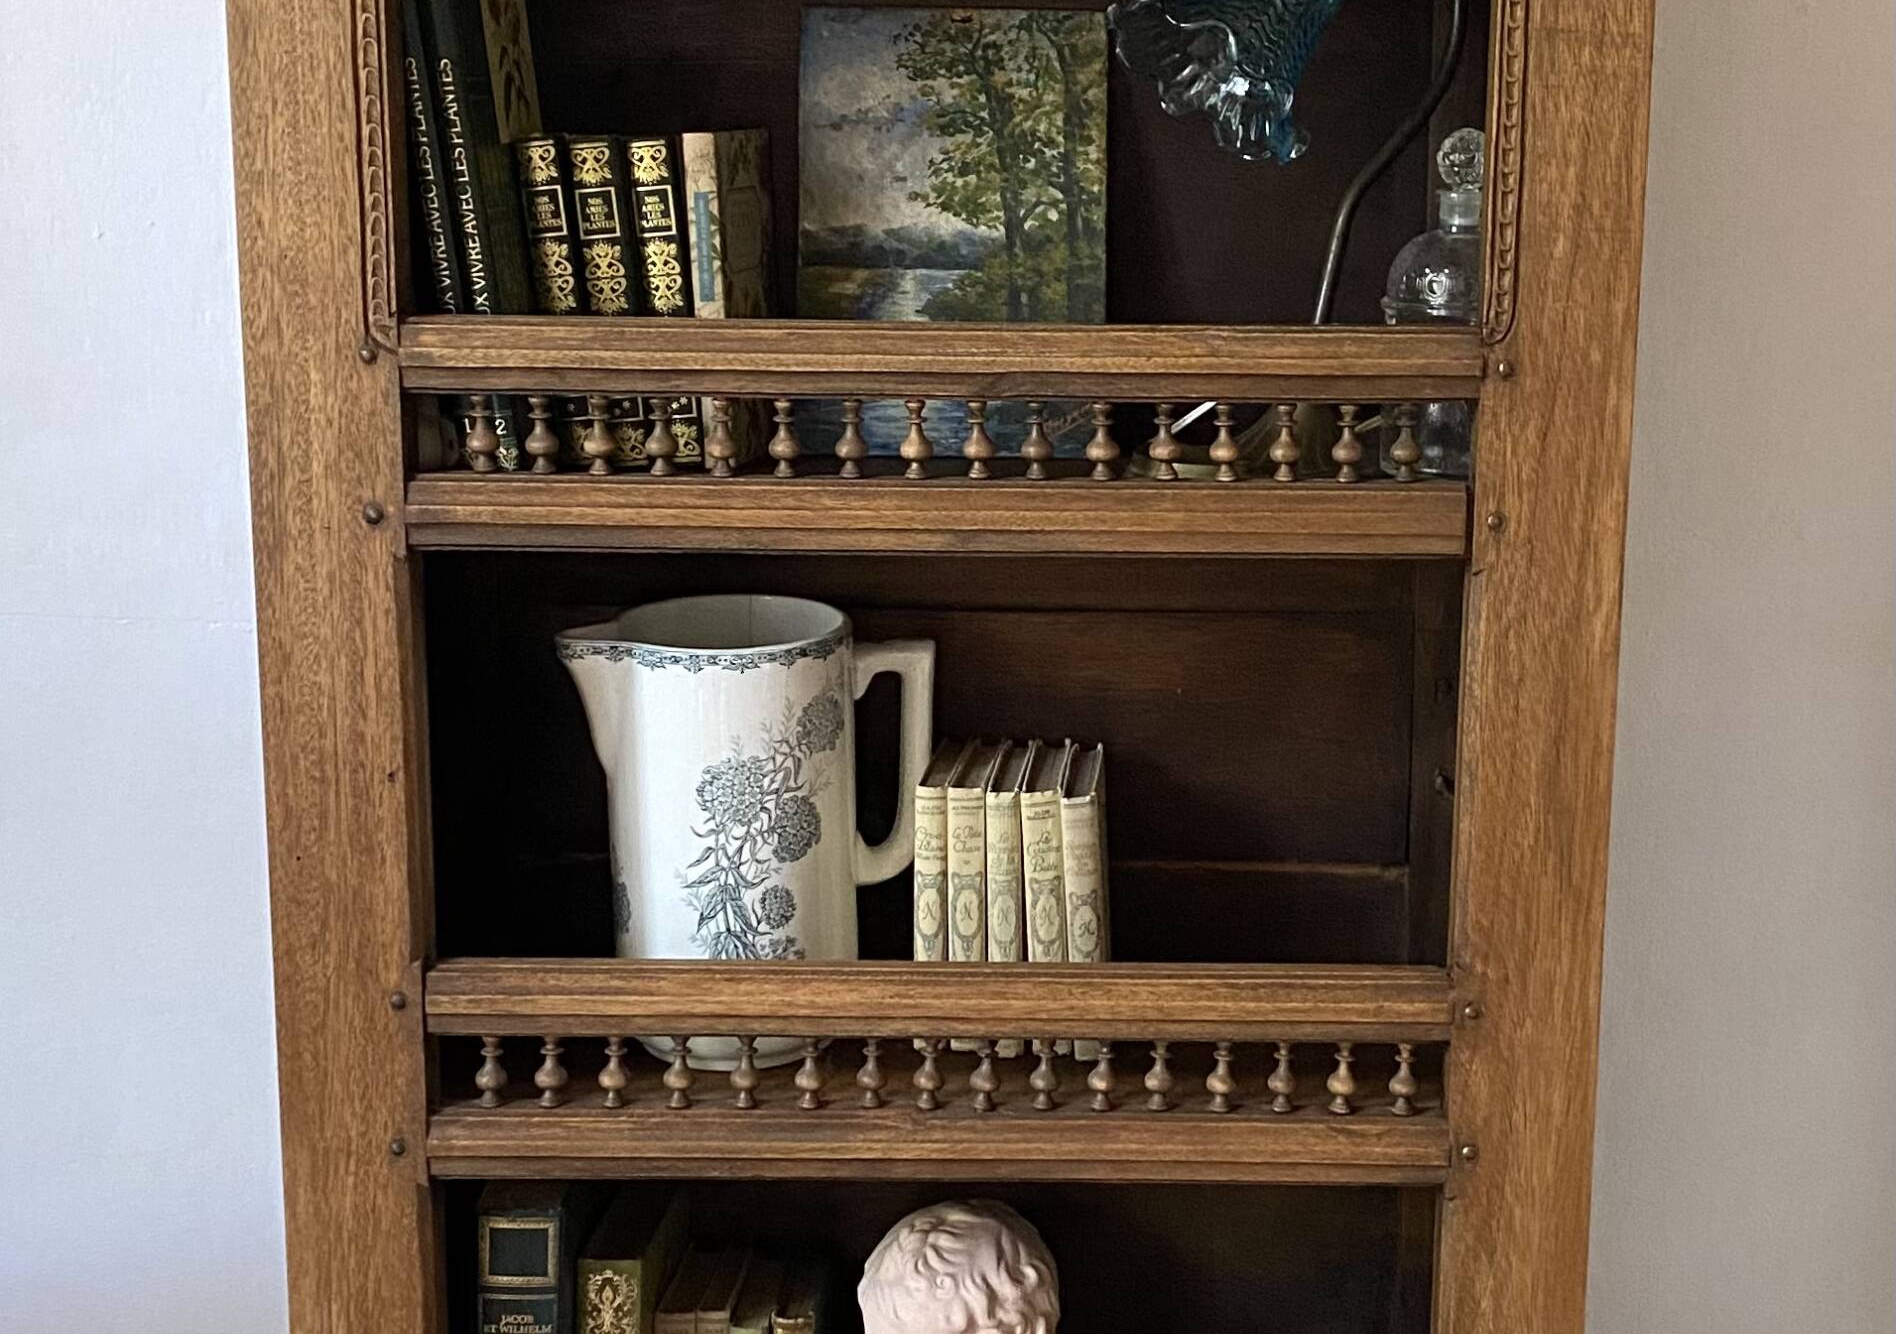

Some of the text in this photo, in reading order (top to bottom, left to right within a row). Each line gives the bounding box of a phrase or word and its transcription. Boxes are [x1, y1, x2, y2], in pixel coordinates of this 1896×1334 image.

[405, 57, 429, 142] PLANTES
[439, 58, 464, 143] PLANTES
[419, 146, 435, 180] LES
[454, 147, 470, 182] LES
[421, 183, 444, 233] AVEC
[456, 184, 478, 234] AVEC
[583, 219, 616, 230] PLANTES
[430, 234, 452, 287] VIVRE
[463, 235, 487, 290] VIVRE
[494, 418, 507, 435] 2
[500, 1314, 534, 1326] JACOB
[500, 1323, 553, 1334] WILHELM
